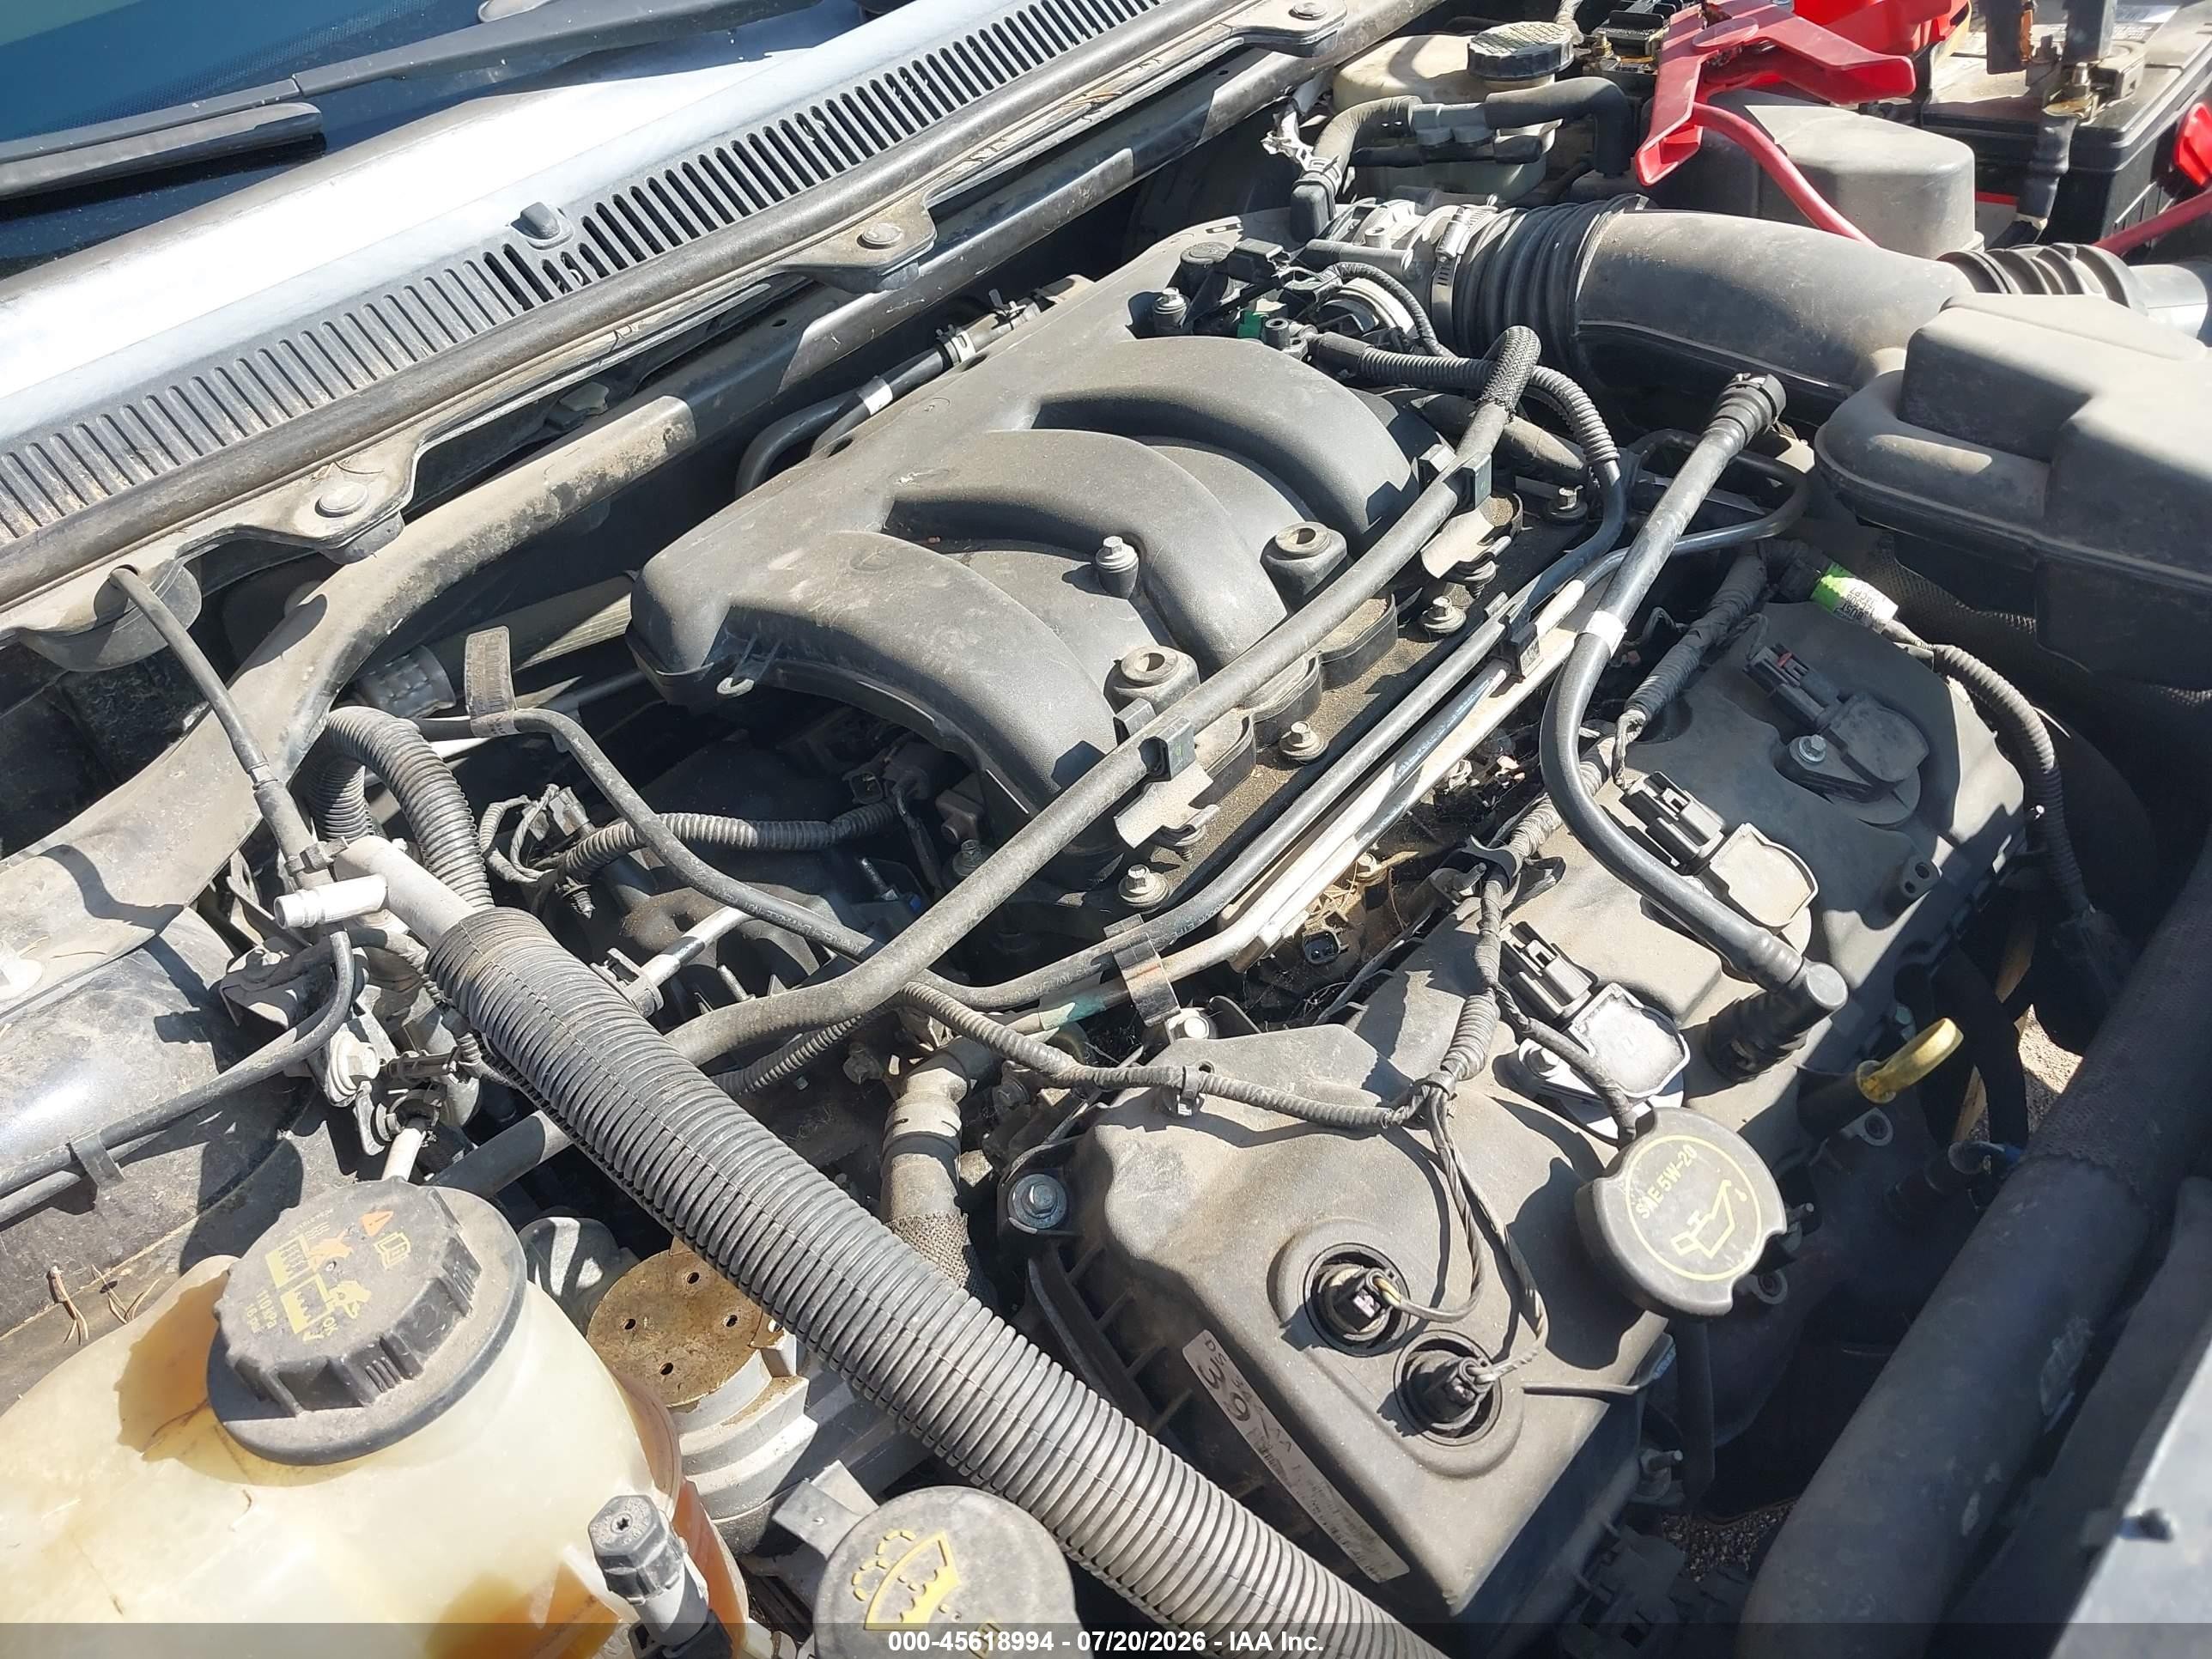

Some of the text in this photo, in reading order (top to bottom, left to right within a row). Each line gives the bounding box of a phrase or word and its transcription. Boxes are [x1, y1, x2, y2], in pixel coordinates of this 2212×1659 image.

[1635, 1144, 1698, 1219] SAE 5W-20
[323, 1316, 339, 1336] OK
